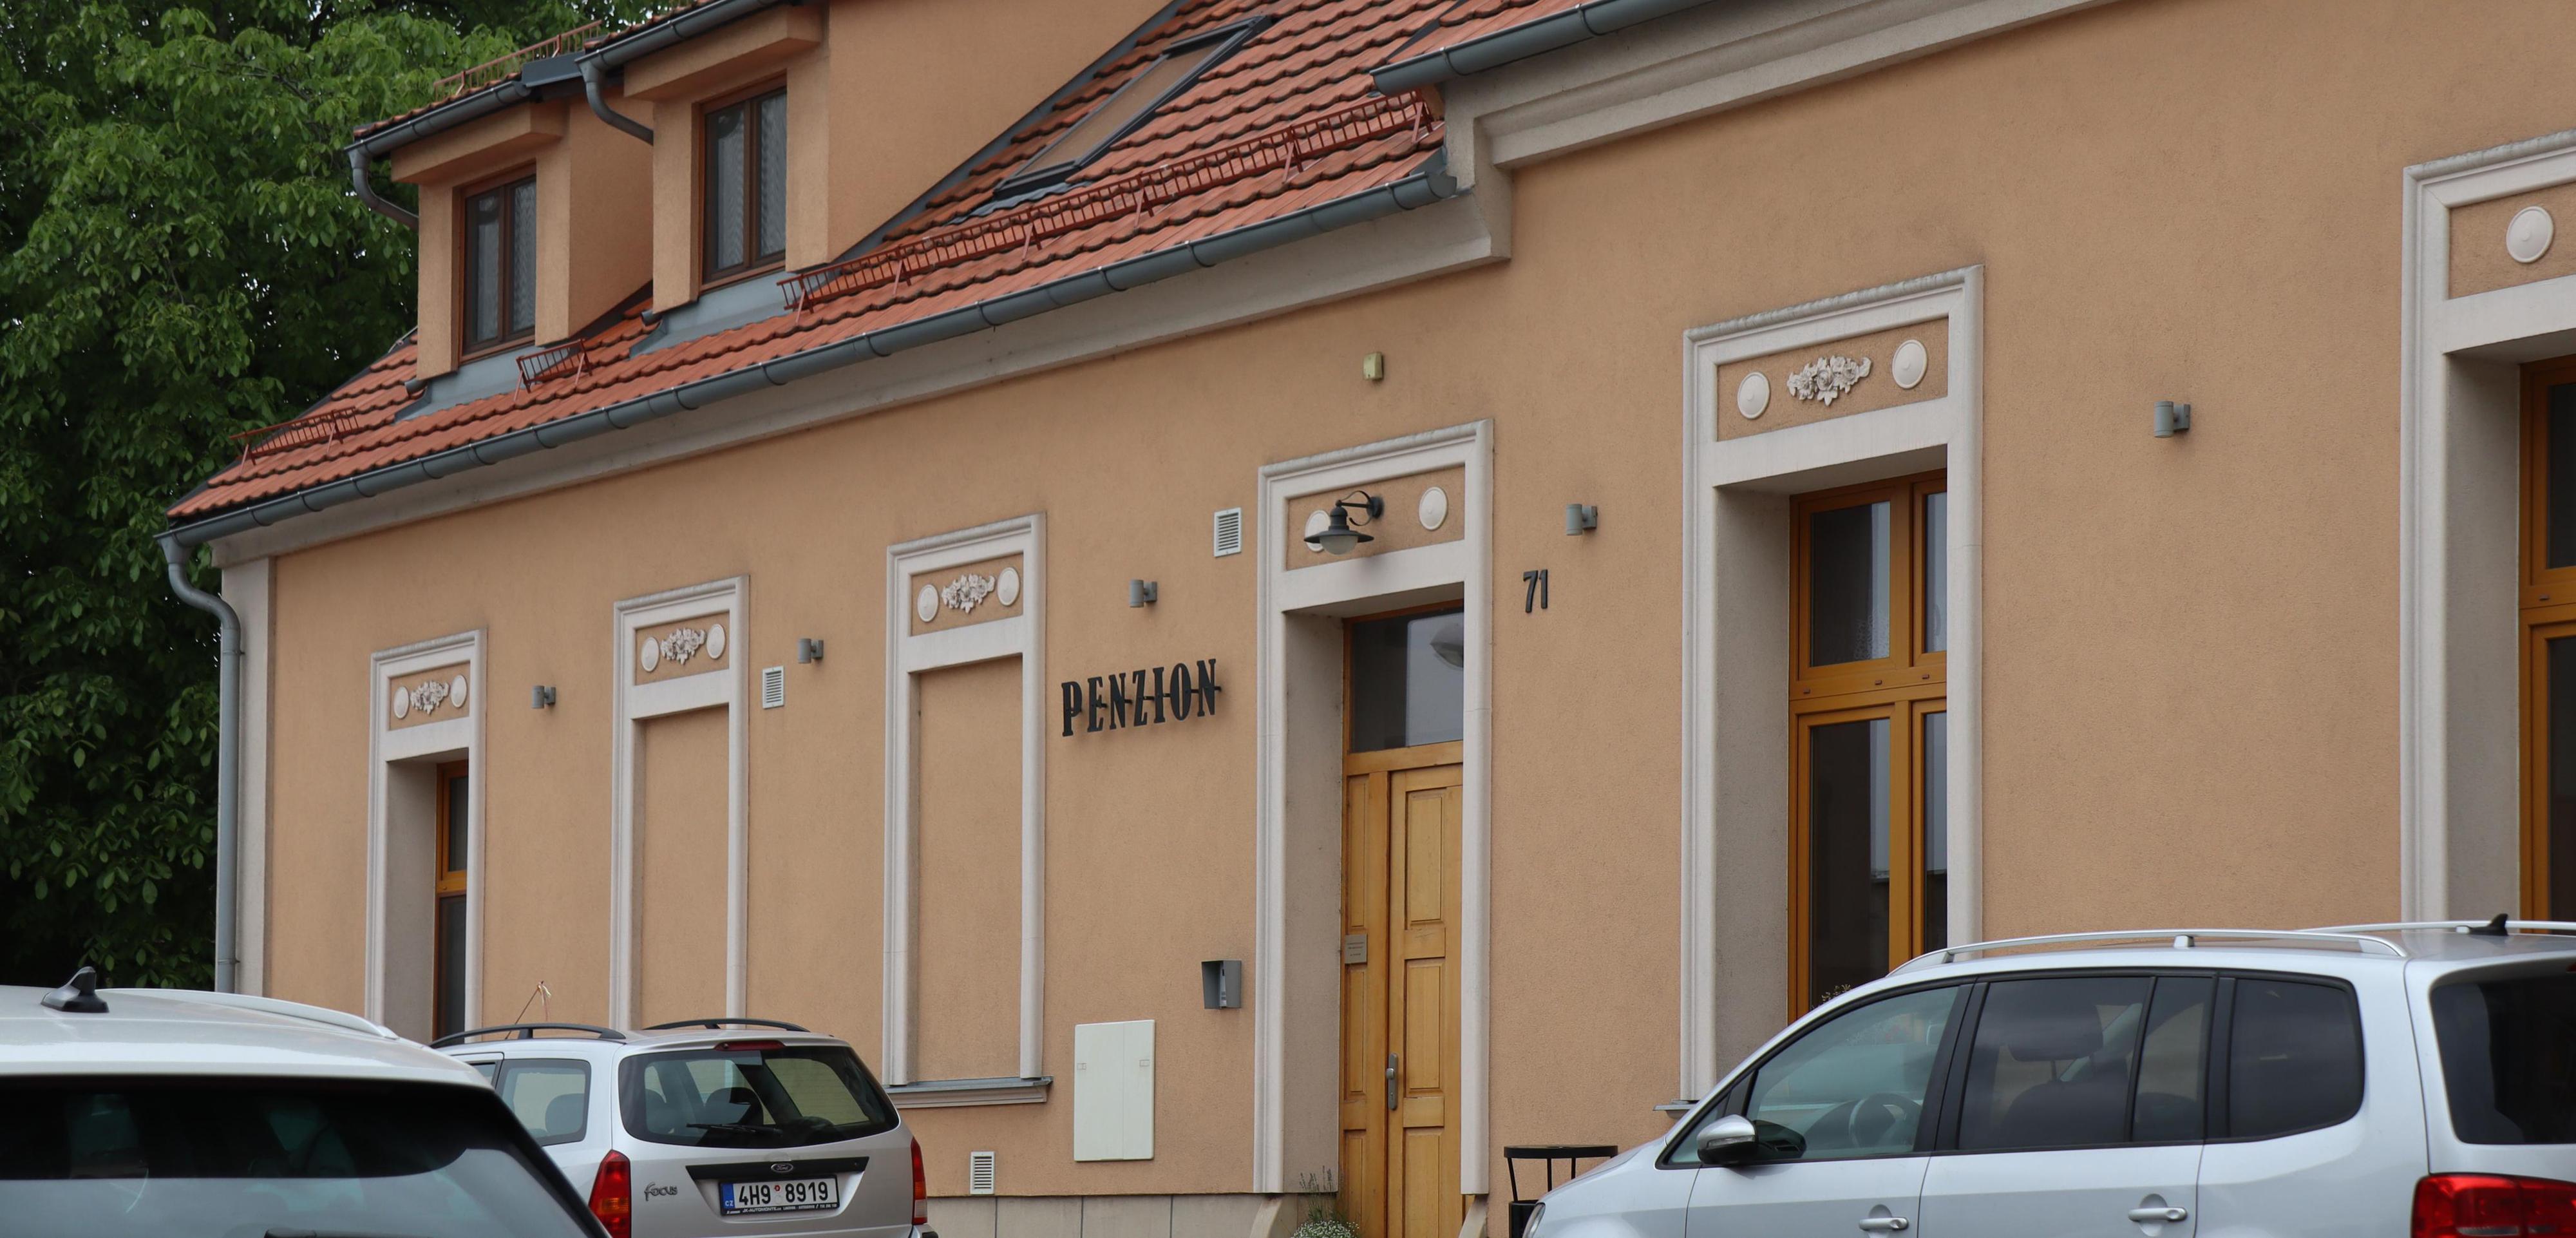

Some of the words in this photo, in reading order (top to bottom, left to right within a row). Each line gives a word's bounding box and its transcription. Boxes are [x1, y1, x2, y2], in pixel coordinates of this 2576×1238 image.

[1523, 569, 1548, 613] 71
[1061, 658, 1217, 736] PENZION
[739, 1185, 771, 1206] 4H9
[785, 1181, 828, 1203] 8919
